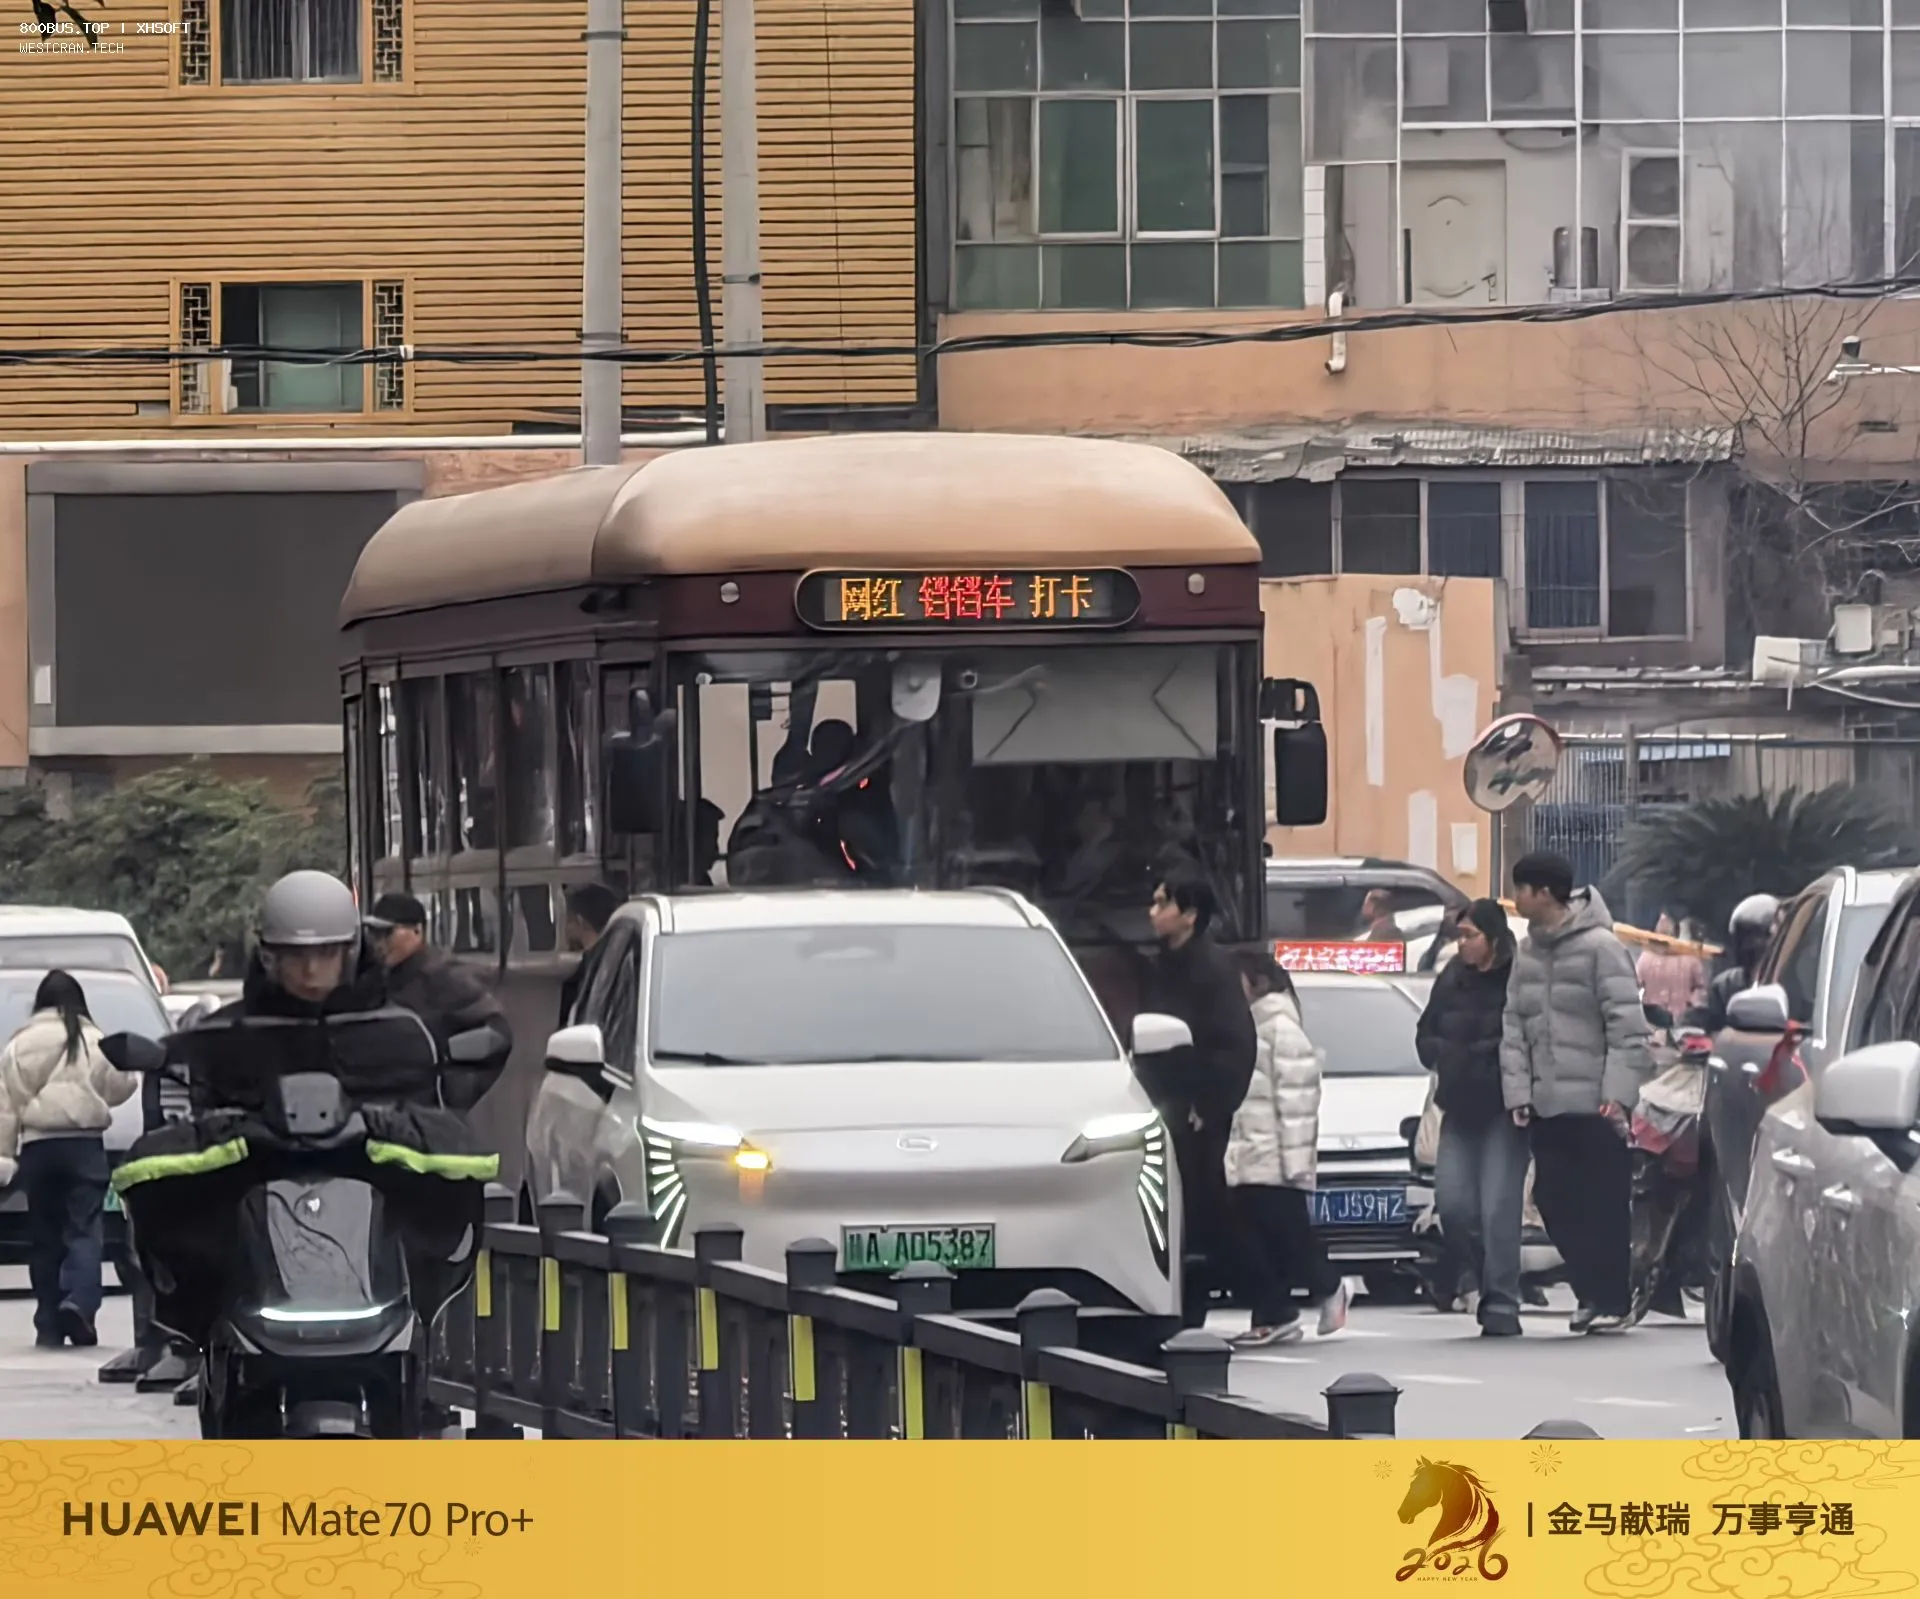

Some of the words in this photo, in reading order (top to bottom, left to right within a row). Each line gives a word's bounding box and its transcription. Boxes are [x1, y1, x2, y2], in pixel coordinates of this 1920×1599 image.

[840, 577, 905, 621] 网红
[919, 575, 1015, 620] 铛铛车
[1029, 575, 1094, 618] 打卡
